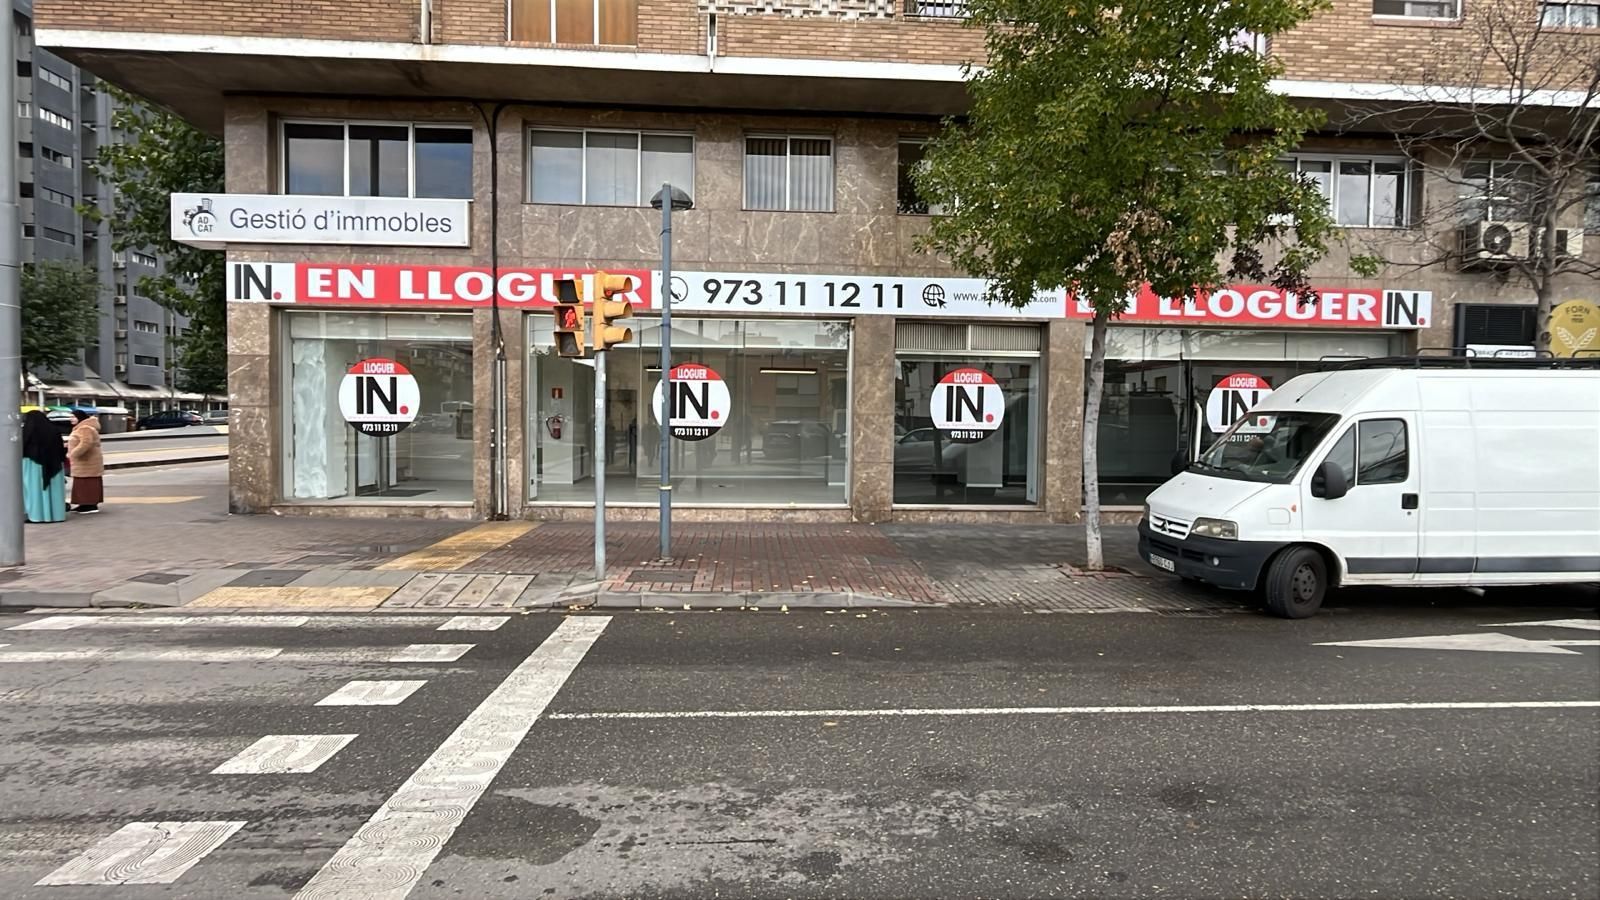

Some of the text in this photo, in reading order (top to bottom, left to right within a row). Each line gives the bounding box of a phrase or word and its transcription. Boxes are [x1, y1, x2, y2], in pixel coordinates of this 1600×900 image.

[198, 216, 209, 224] AD
[230, 208, 306, 230] Gestió
[197, 225, 213, 233] CAT
[234, 263, 282, 300] IN.
[307, 267, 376, 299] EN
[703, 278, 904, 308] 973 11 12 11
[1158, 288, 1377, 322] LLOGUER
[1385, 292, 1426, 326] IN.
[363, 362, 396, 374] LLOGUER
[677, 368, 708, 379] LLOGUER
[953, 372, 983, 383] LLOGUER
[1229, 377, 1258, 388] LLOGUER
[356, 376, 409, 415] IN.
[670, 381, 720, 420] IN.
[946, 385, 994, 423] IN.
[362, 423, 398, 432] 973 11 12 11
[674, 427, 709, 436] 973 11 12 11
[951, 430, 984, 439] 973 11 12 11
